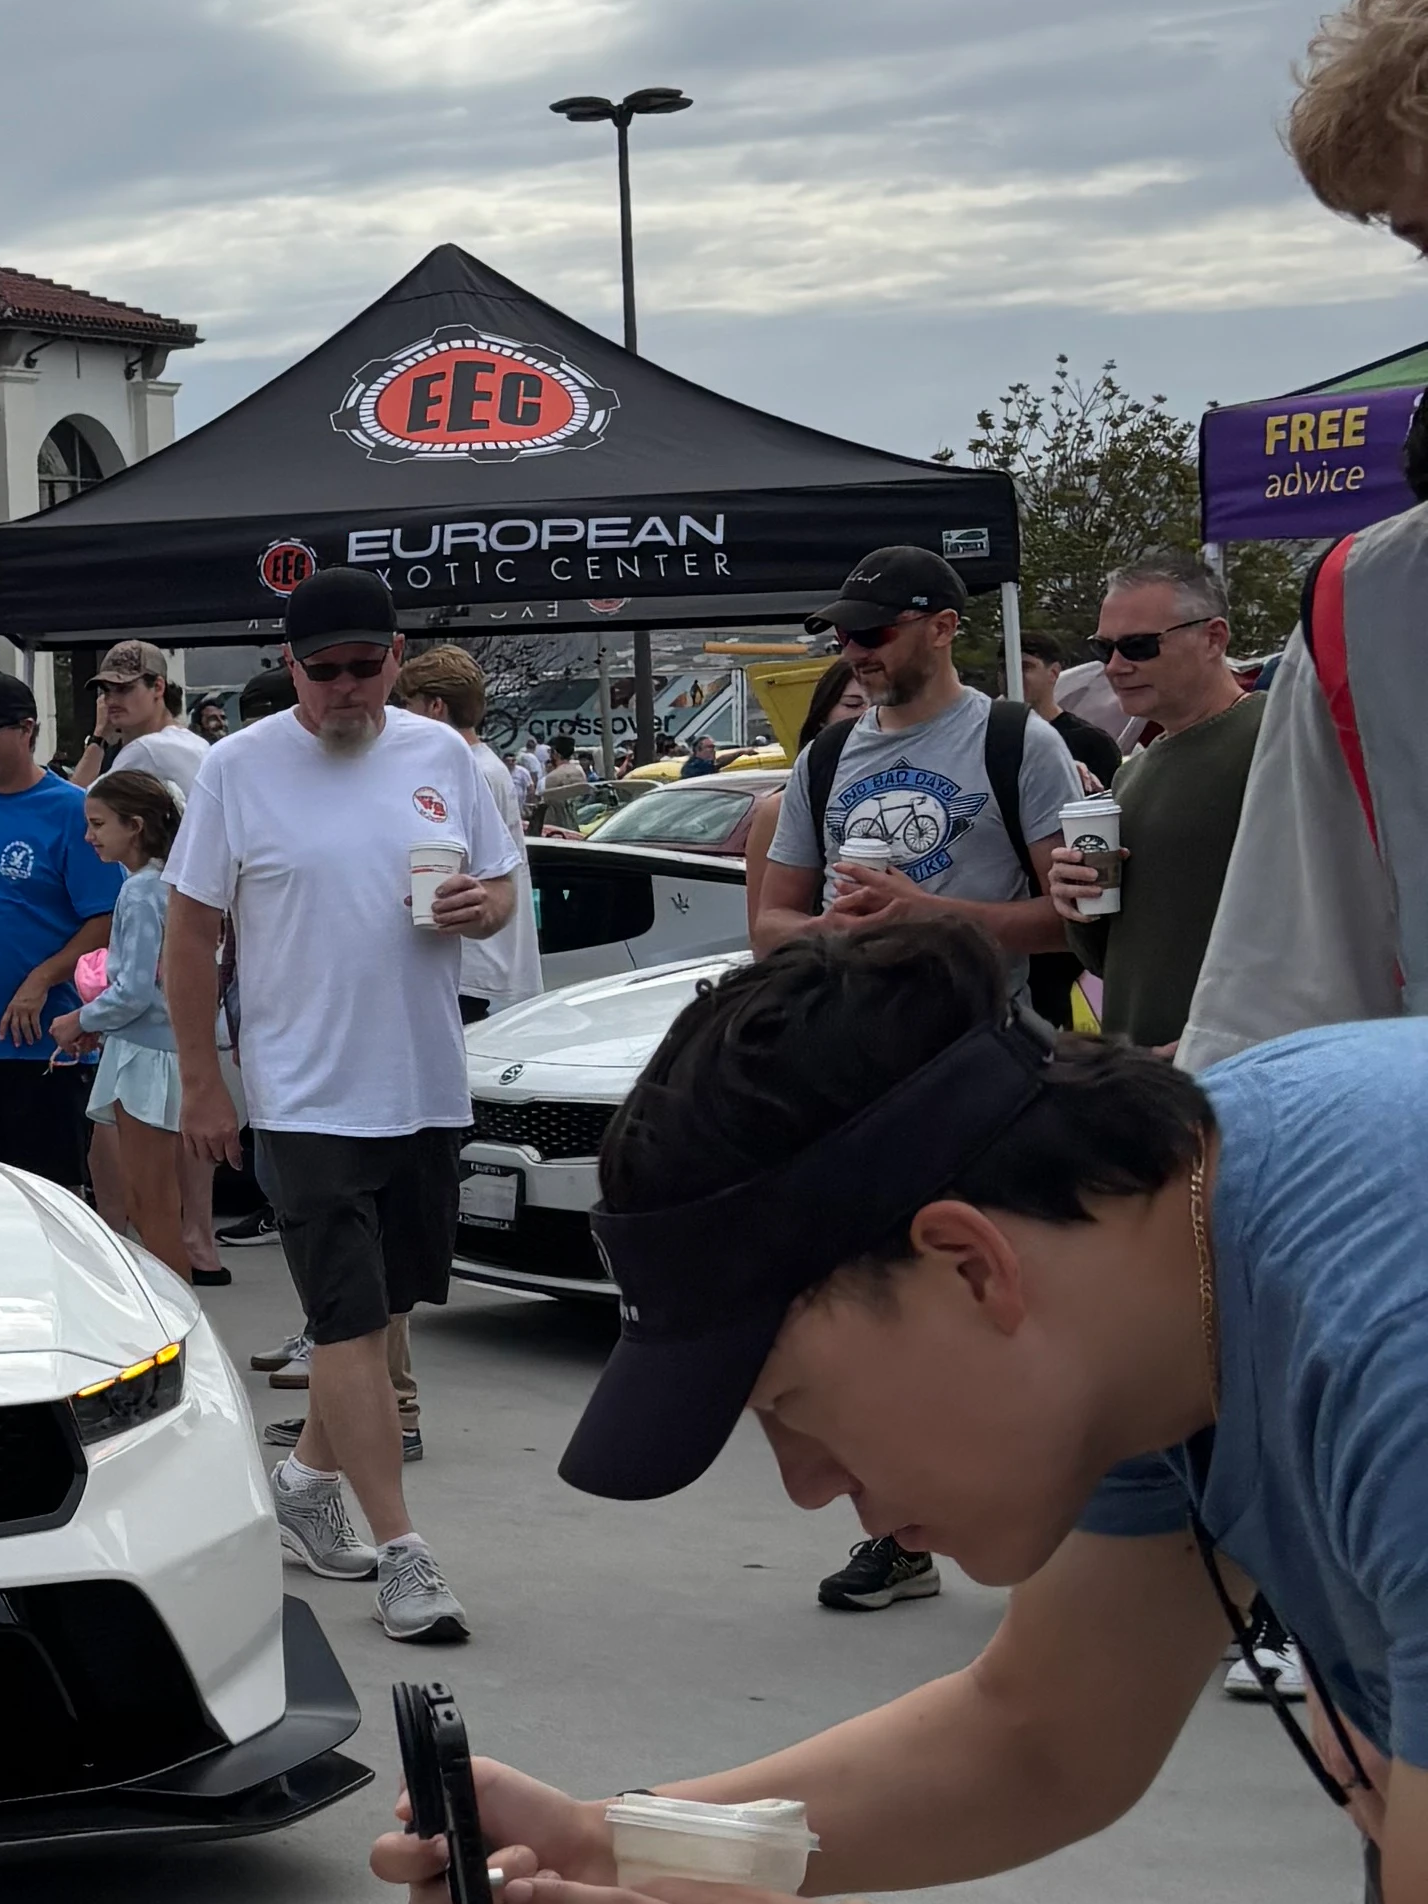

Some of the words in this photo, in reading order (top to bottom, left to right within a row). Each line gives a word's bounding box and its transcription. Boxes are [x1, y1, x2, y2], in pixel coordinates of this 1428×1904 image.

[407, 360, 543, 434] EEC
[1265, 406, 1369, 456] FREE
[1265, 461, 1365, 498] advice
[347, 514, 724, 563] EUROPEAN
[377, 559, 517, 591] XOTIC
[550, 552, 731, 581] CENTER
[915, 772, 955, 796] DAYS
